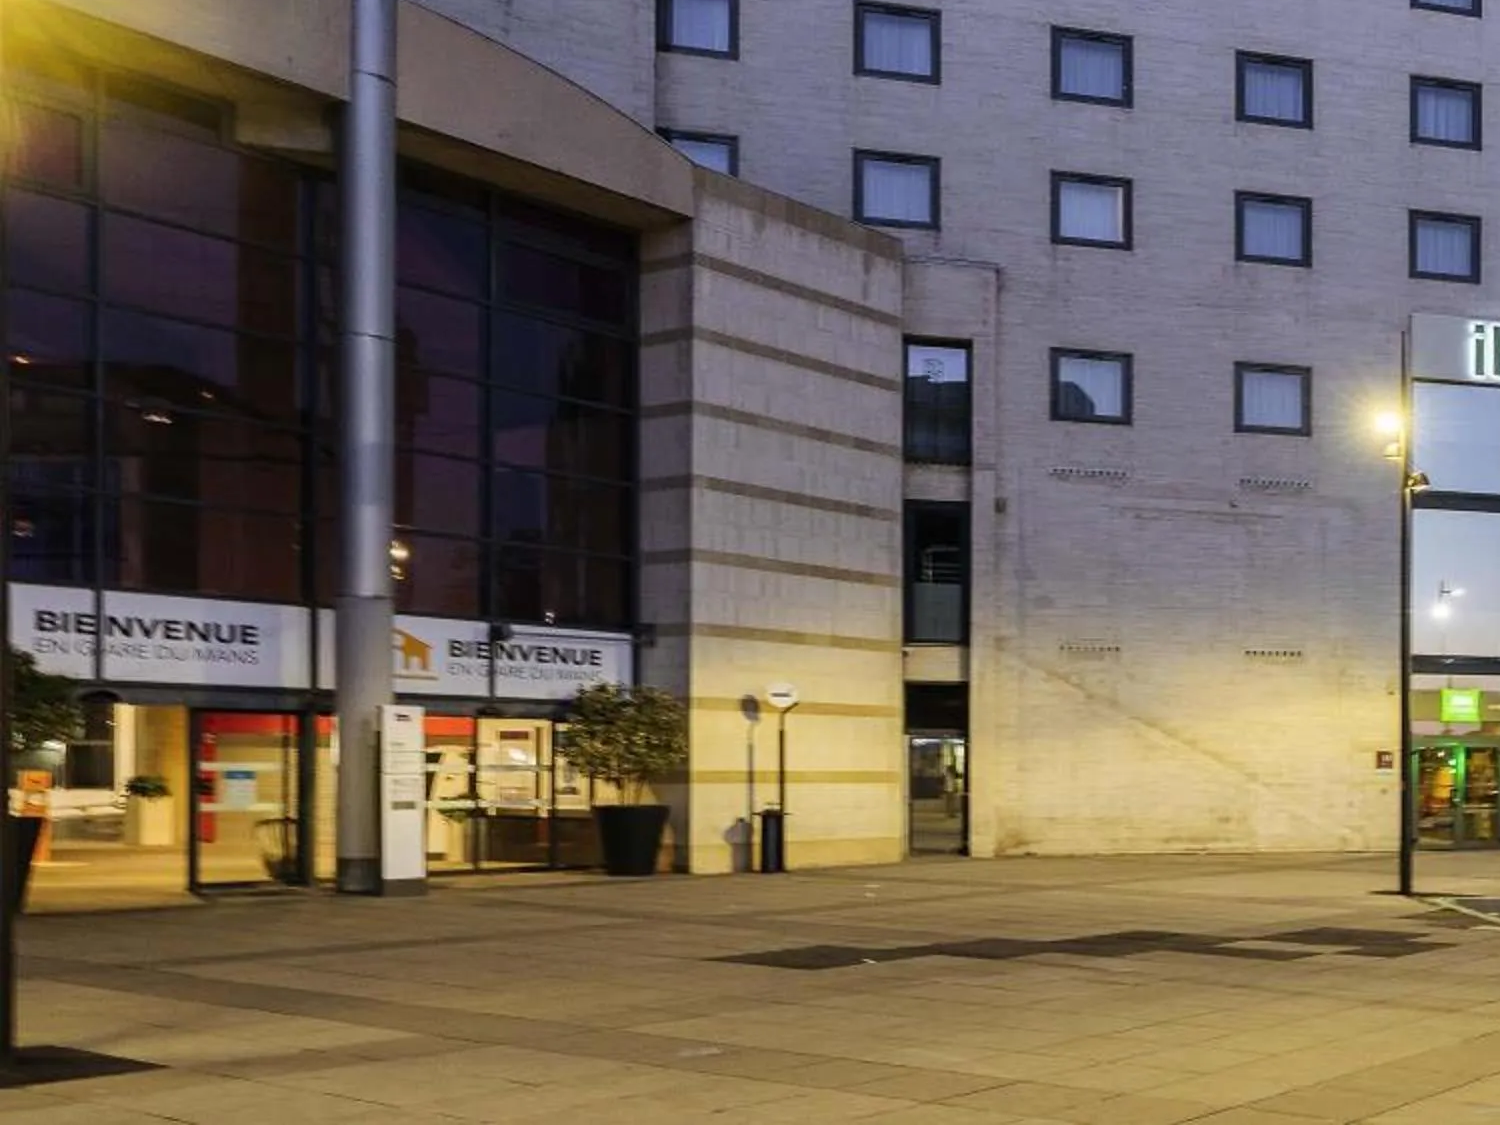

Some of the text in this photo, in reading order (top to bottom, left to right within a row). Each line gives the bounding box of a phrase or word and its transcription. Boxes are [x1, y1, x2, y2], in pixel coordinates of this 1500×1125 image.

[34, 609, 260, 646] BIENVENUE
[33, 637, 70, 654] EN
[448, 639, 603, 667] BIENVENUE
